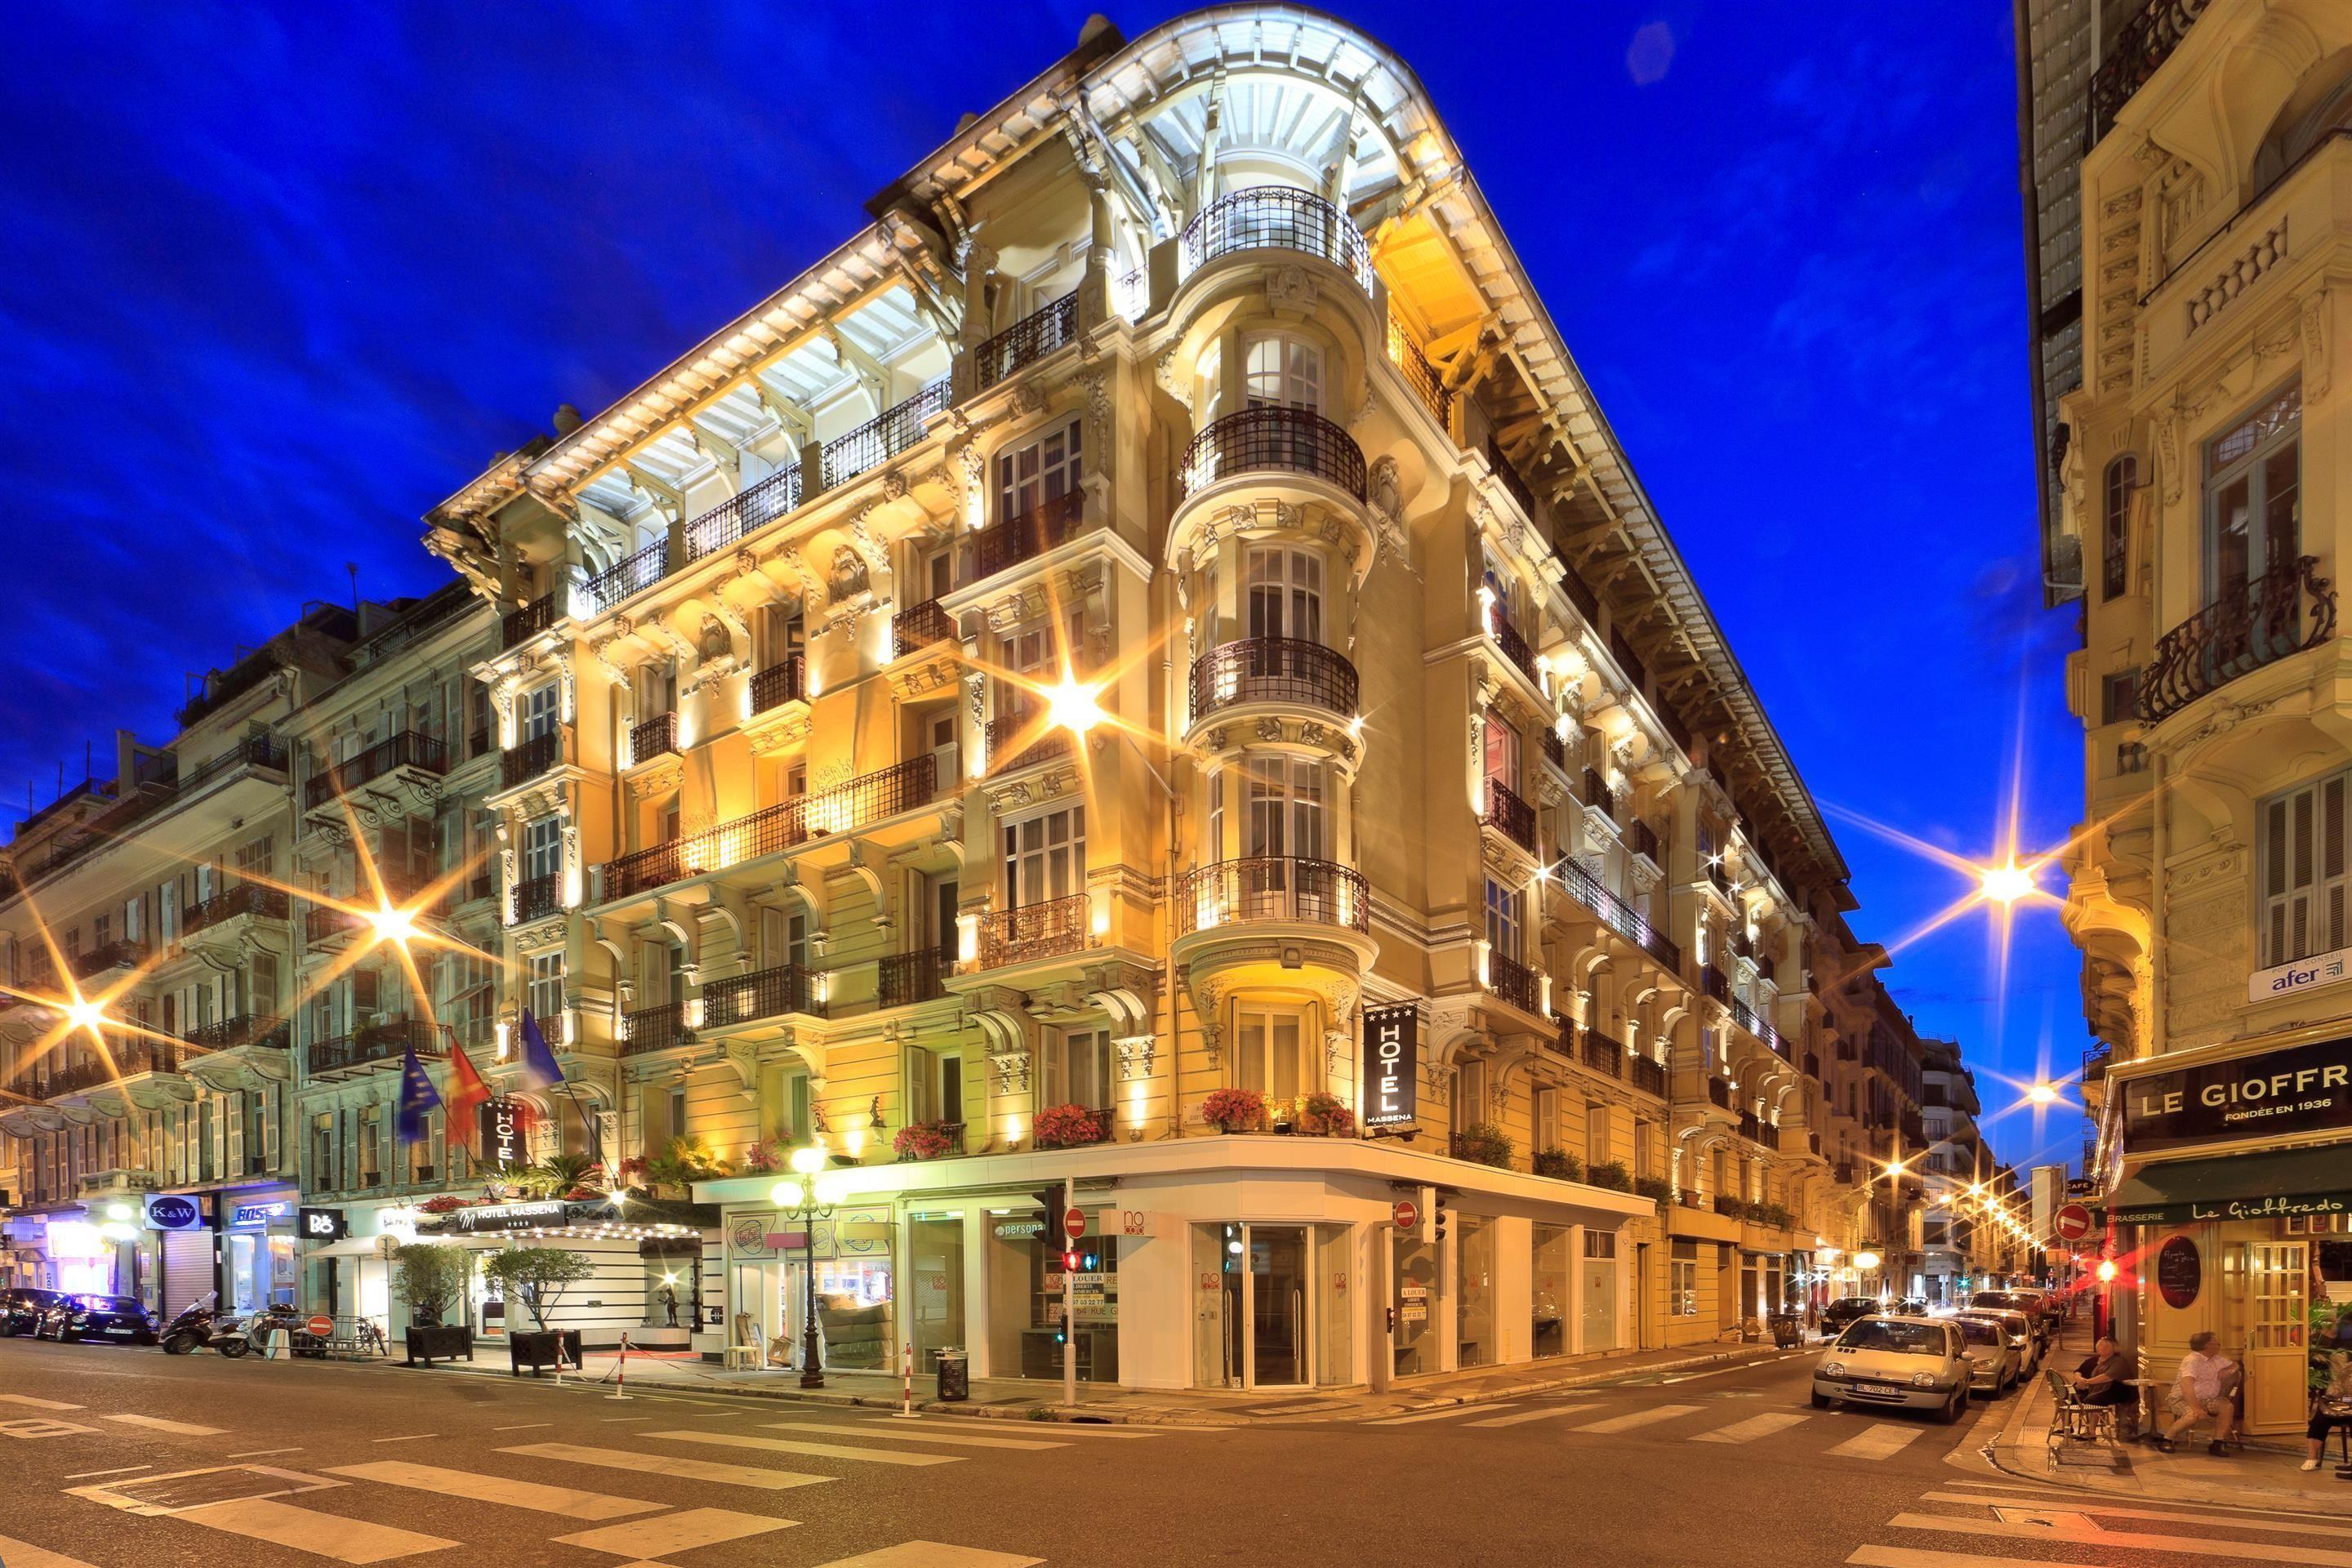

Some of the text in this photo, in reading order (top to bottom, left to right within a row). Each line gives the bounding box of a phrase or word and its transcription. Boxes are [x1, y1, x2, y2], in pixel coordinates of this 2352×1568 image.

[2272, 951, 2344, 973] POINT CONSEIL
[2272, 969, 2319, 991] afer
[1379, 1024, 1401, 1111] HOTEL
[2142, 1091, 2183, 1117] LE
[2225, 1098, 2332, 1121] FONDÉE EN 1936
[1367, 1114, 1413, 1124] MASSENA
[478, 1208, 510, 1219] HOTEL
[510, 1204, 560, 1217] MASSENA
[2106, 1213, 2164, 1223] BRASSERIE
[2193, 1197, 2344, 1220] Le Gioffredo
